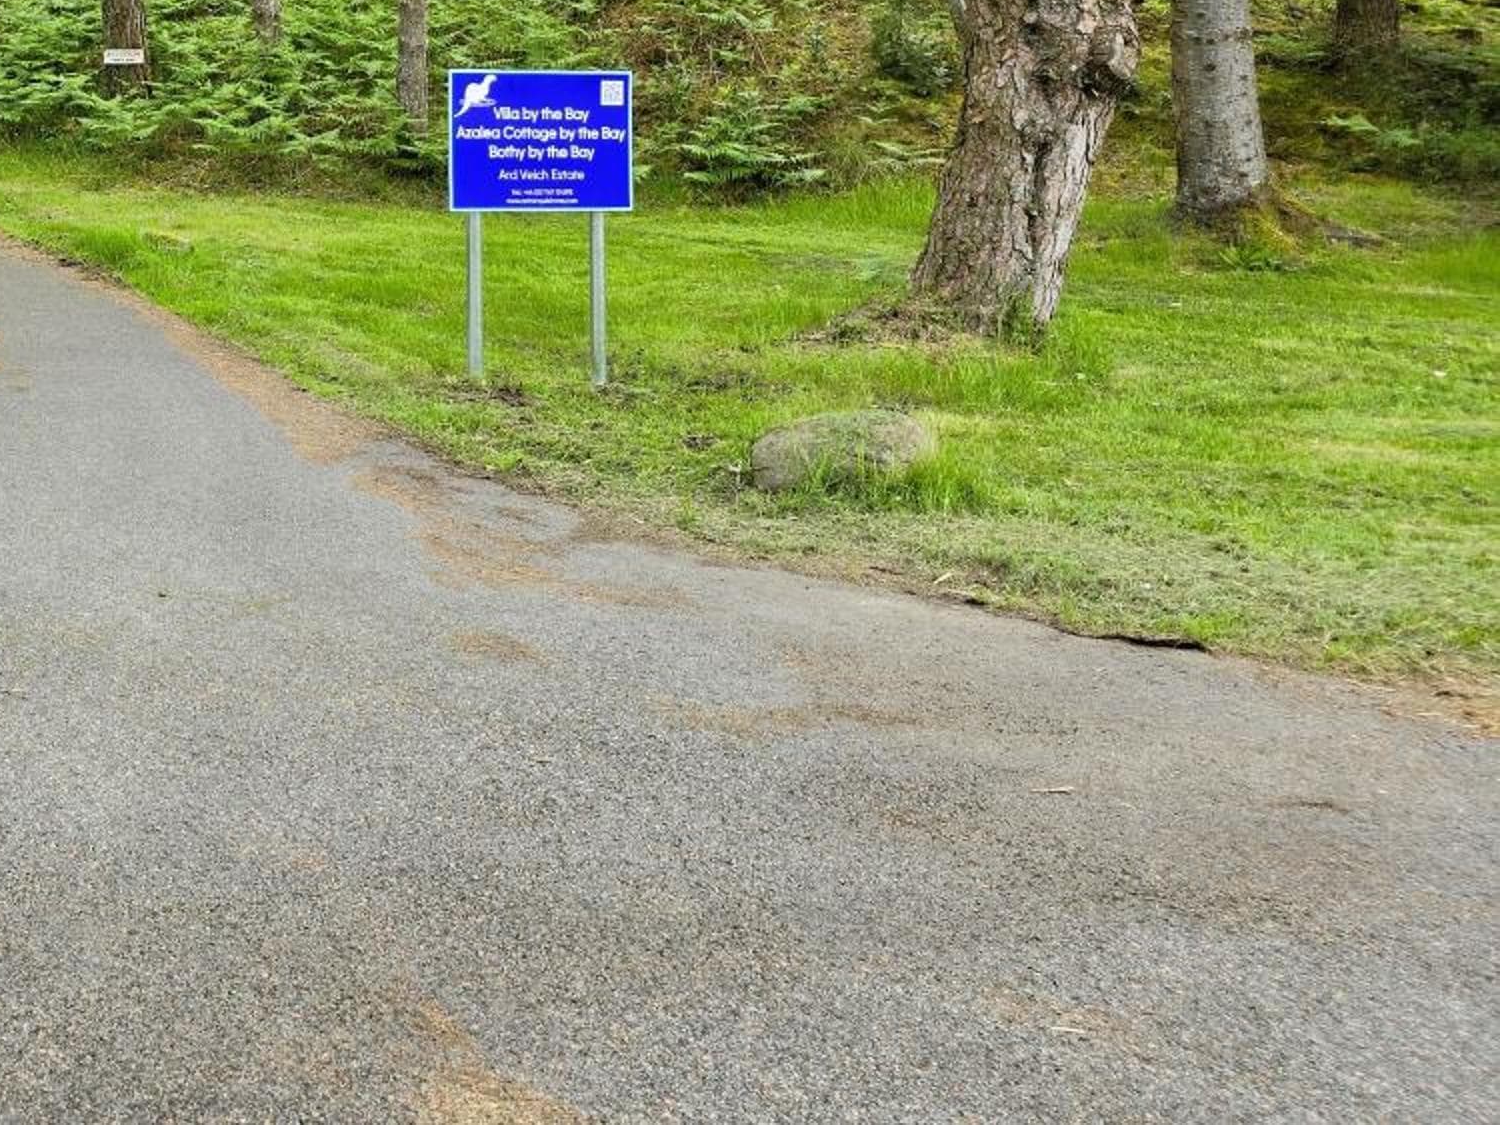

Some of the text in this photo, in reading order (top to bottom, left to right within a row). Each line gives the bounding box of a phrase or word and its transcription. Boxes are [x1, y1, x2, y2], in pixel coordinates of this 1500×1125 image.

[493, 106, 589, 123] Villa by the Bay
[456, 126, 626, 142] Azalea Cottage by the Bay
[488, 145, 595, 161] Bothy by the Bay
[498, 168, 518, 180] Ard
[551, 168, 586, 180] Estate
